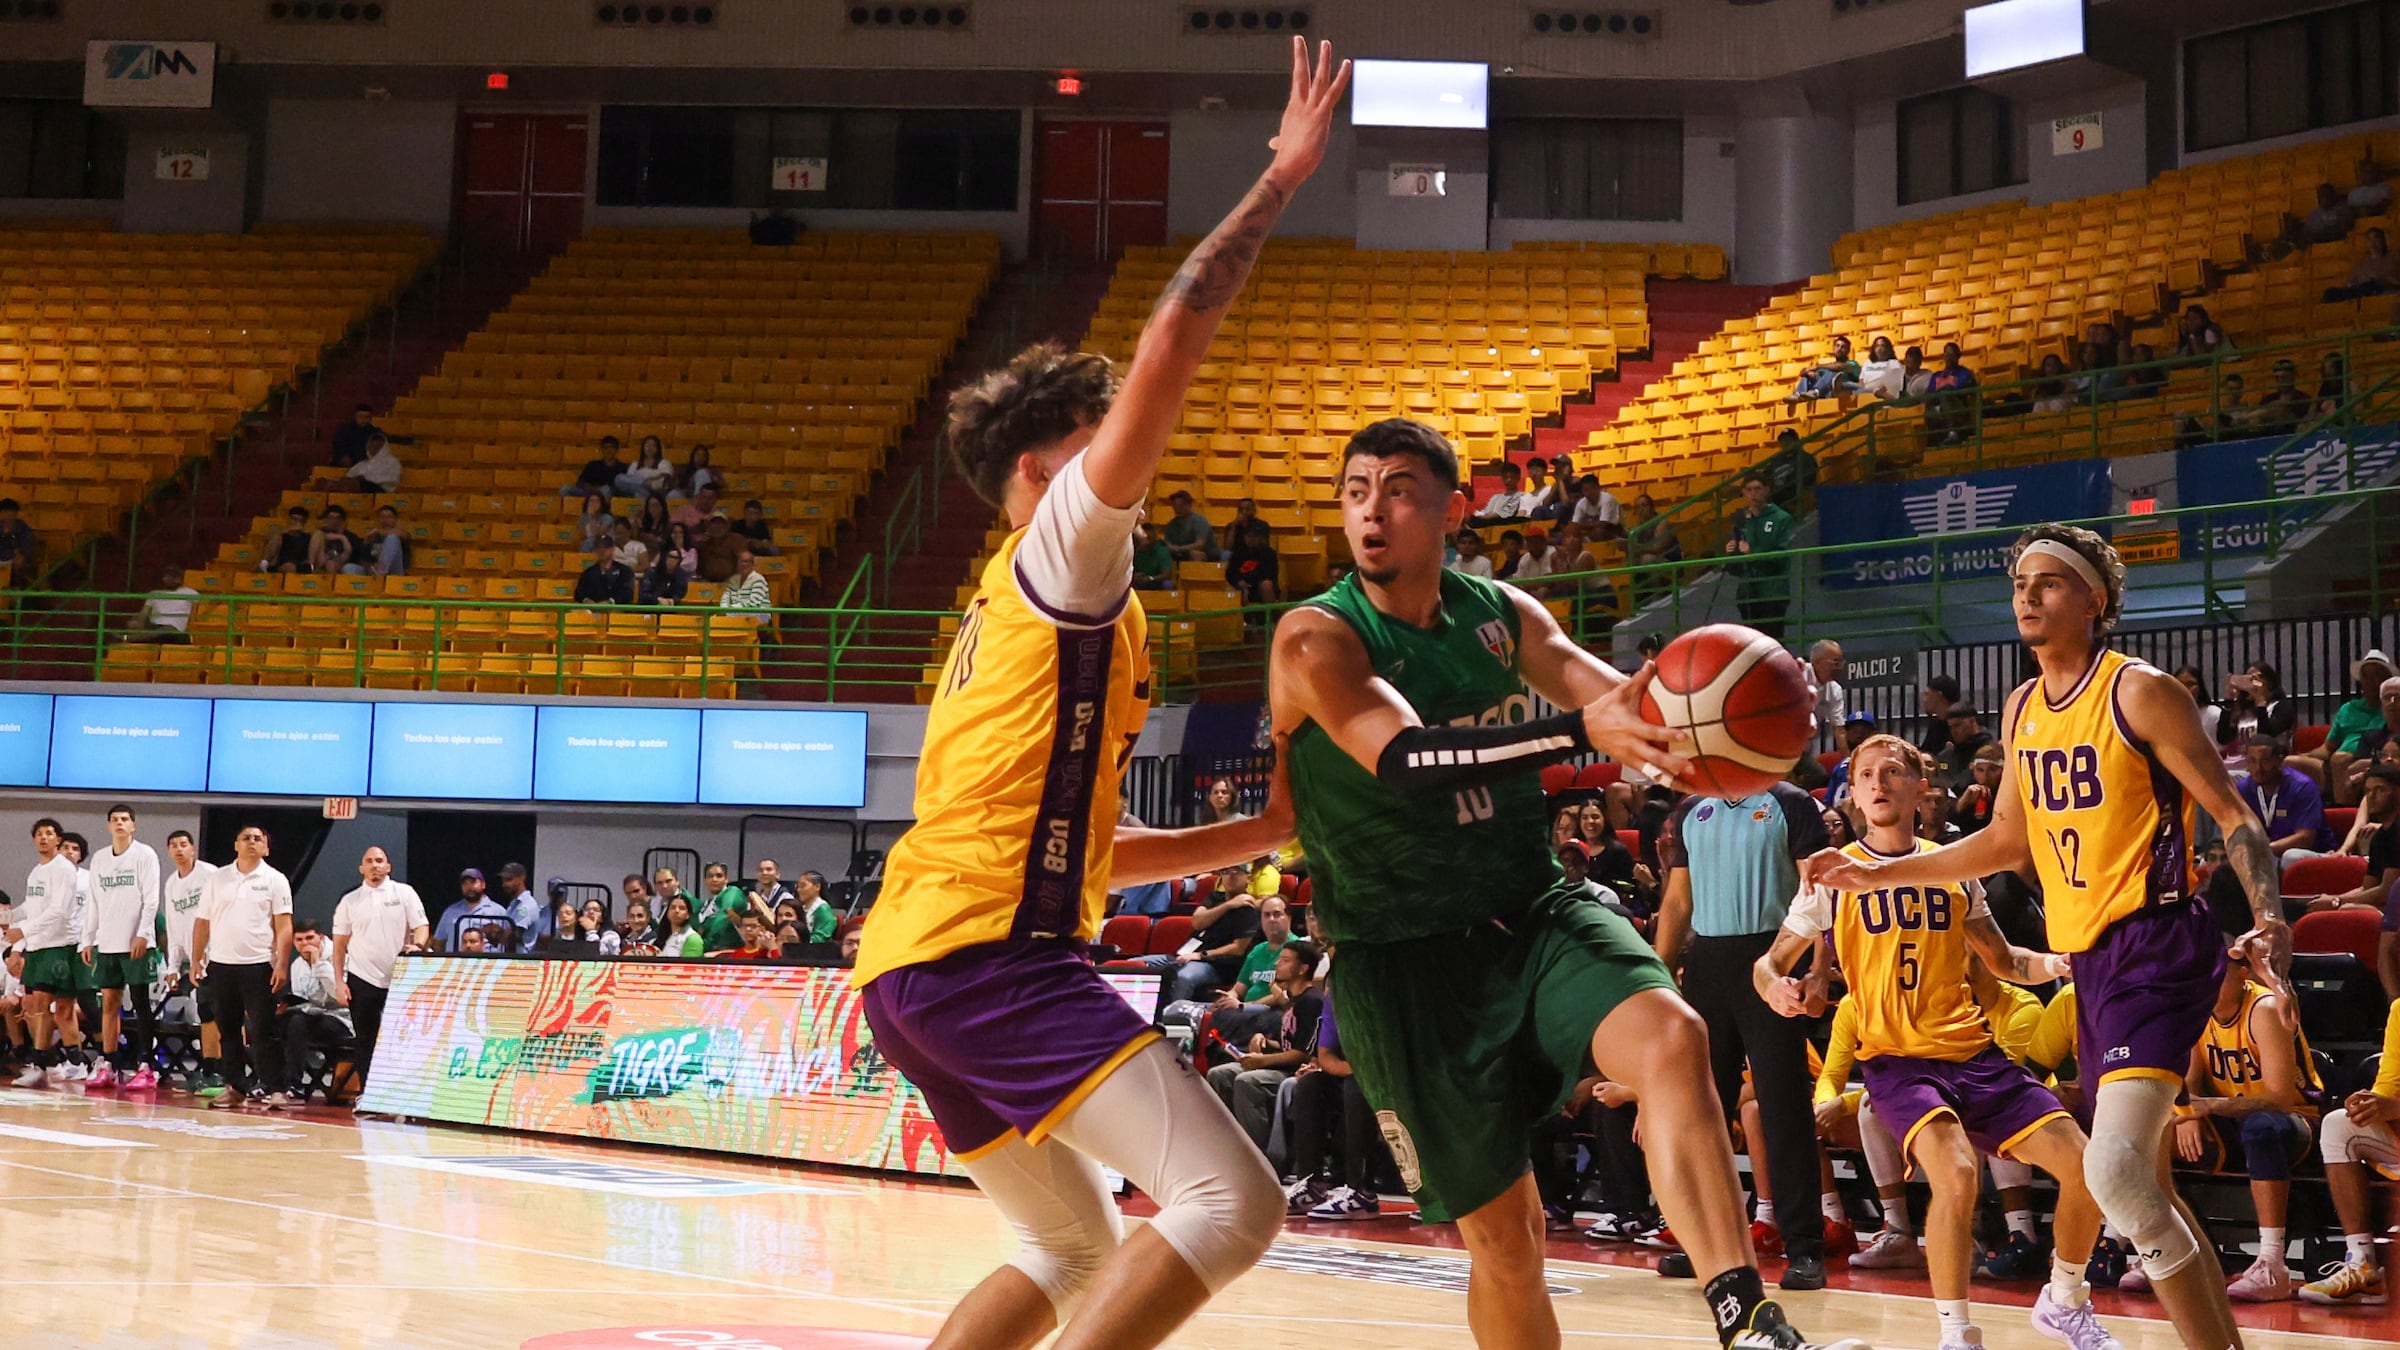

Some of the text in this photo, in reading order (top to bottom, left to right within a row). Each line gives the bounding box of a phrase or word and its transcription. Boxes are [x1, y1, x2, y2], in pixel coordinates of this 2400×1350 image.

[2073, 129, 2084, 150] 9
[170, 159, 194, 178] 12
[787, 169, 809, 188] 11
[1848, 656, 1902, 680] PALCO 2
[2018, 744, 2105, 813] UCB
[329, 798, 353, 817] EXIT
[1043, 817, 1070, 874] UCB
[1857, 886, 1951, 935] UCB
[1898, 943, 1918, 991] 5
[608, 1032, 698, 1096] TIGRE
